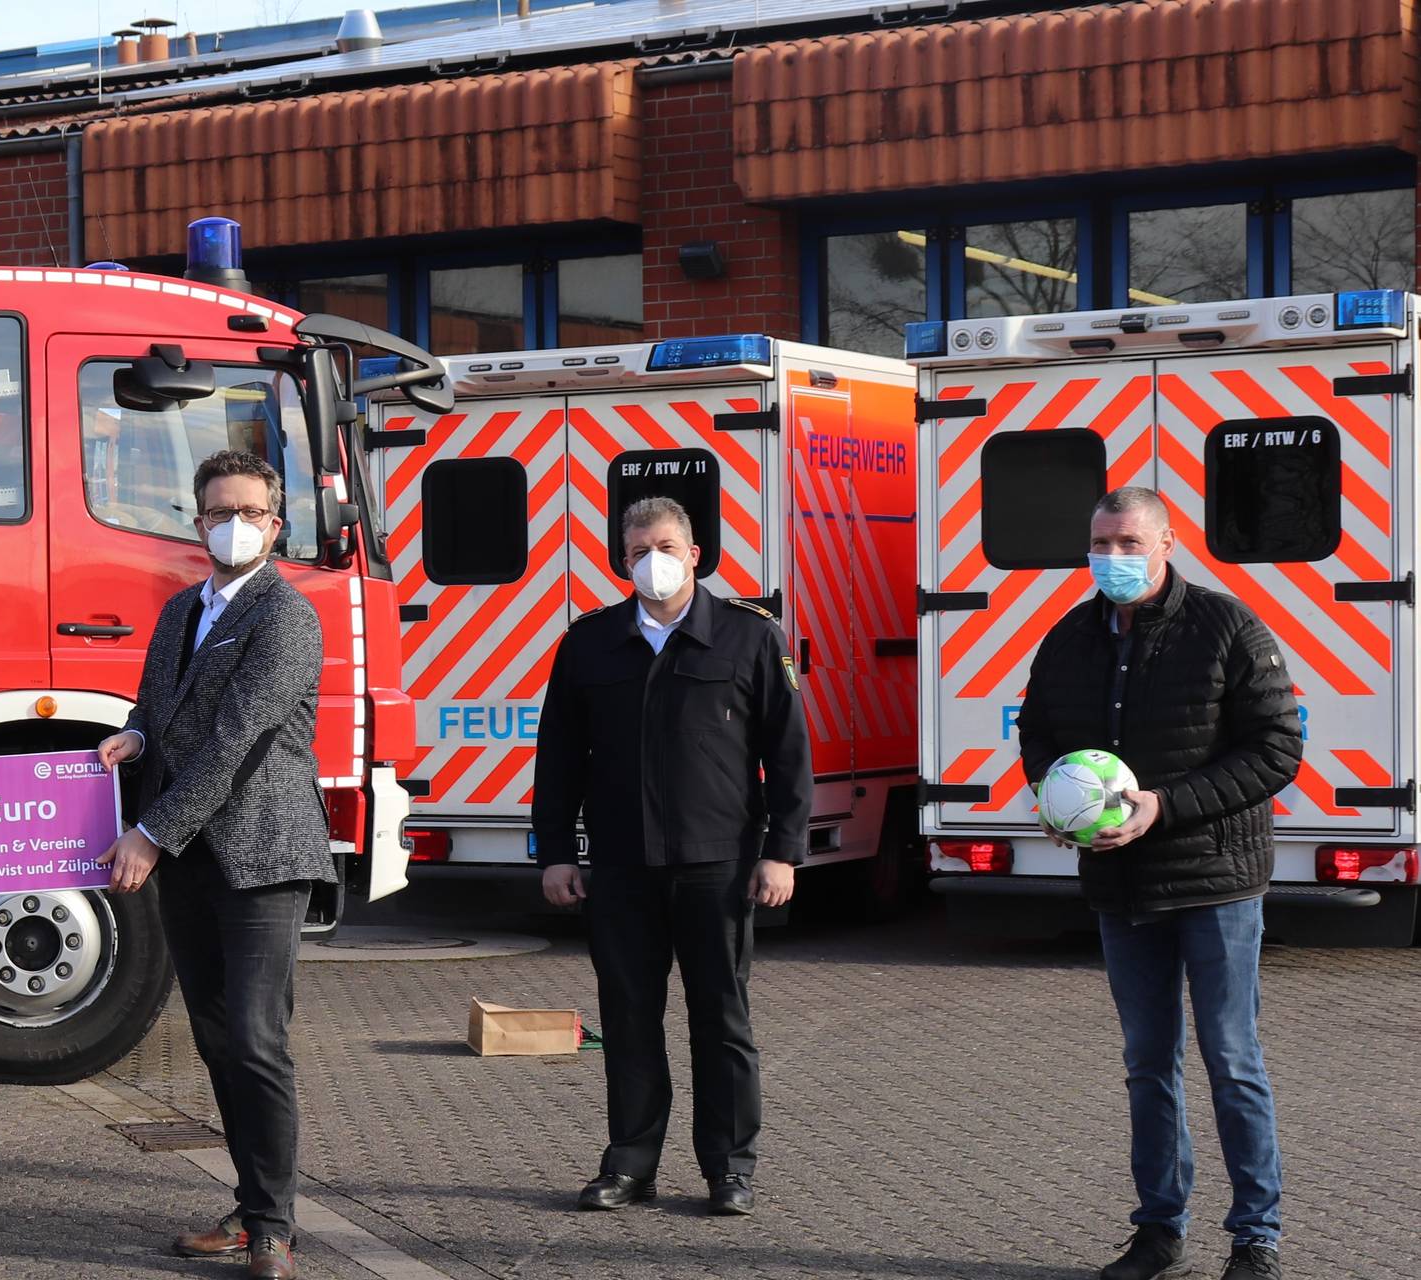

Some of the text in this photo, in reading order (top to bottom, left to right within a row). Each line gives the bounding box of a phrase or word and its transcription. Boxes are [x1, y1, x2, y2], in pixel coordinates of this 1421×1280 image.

[1223, 429, 1322, 448] ERF / RTW / 6
[808, 433, 907, 475] FEUERWEHR
[621, 460, 707, 477] ERF / RTW / 11
[12, 839, 27, 852] &
[29, 837, 86, 852] Vereine
[26, 861, 54, 874] und
